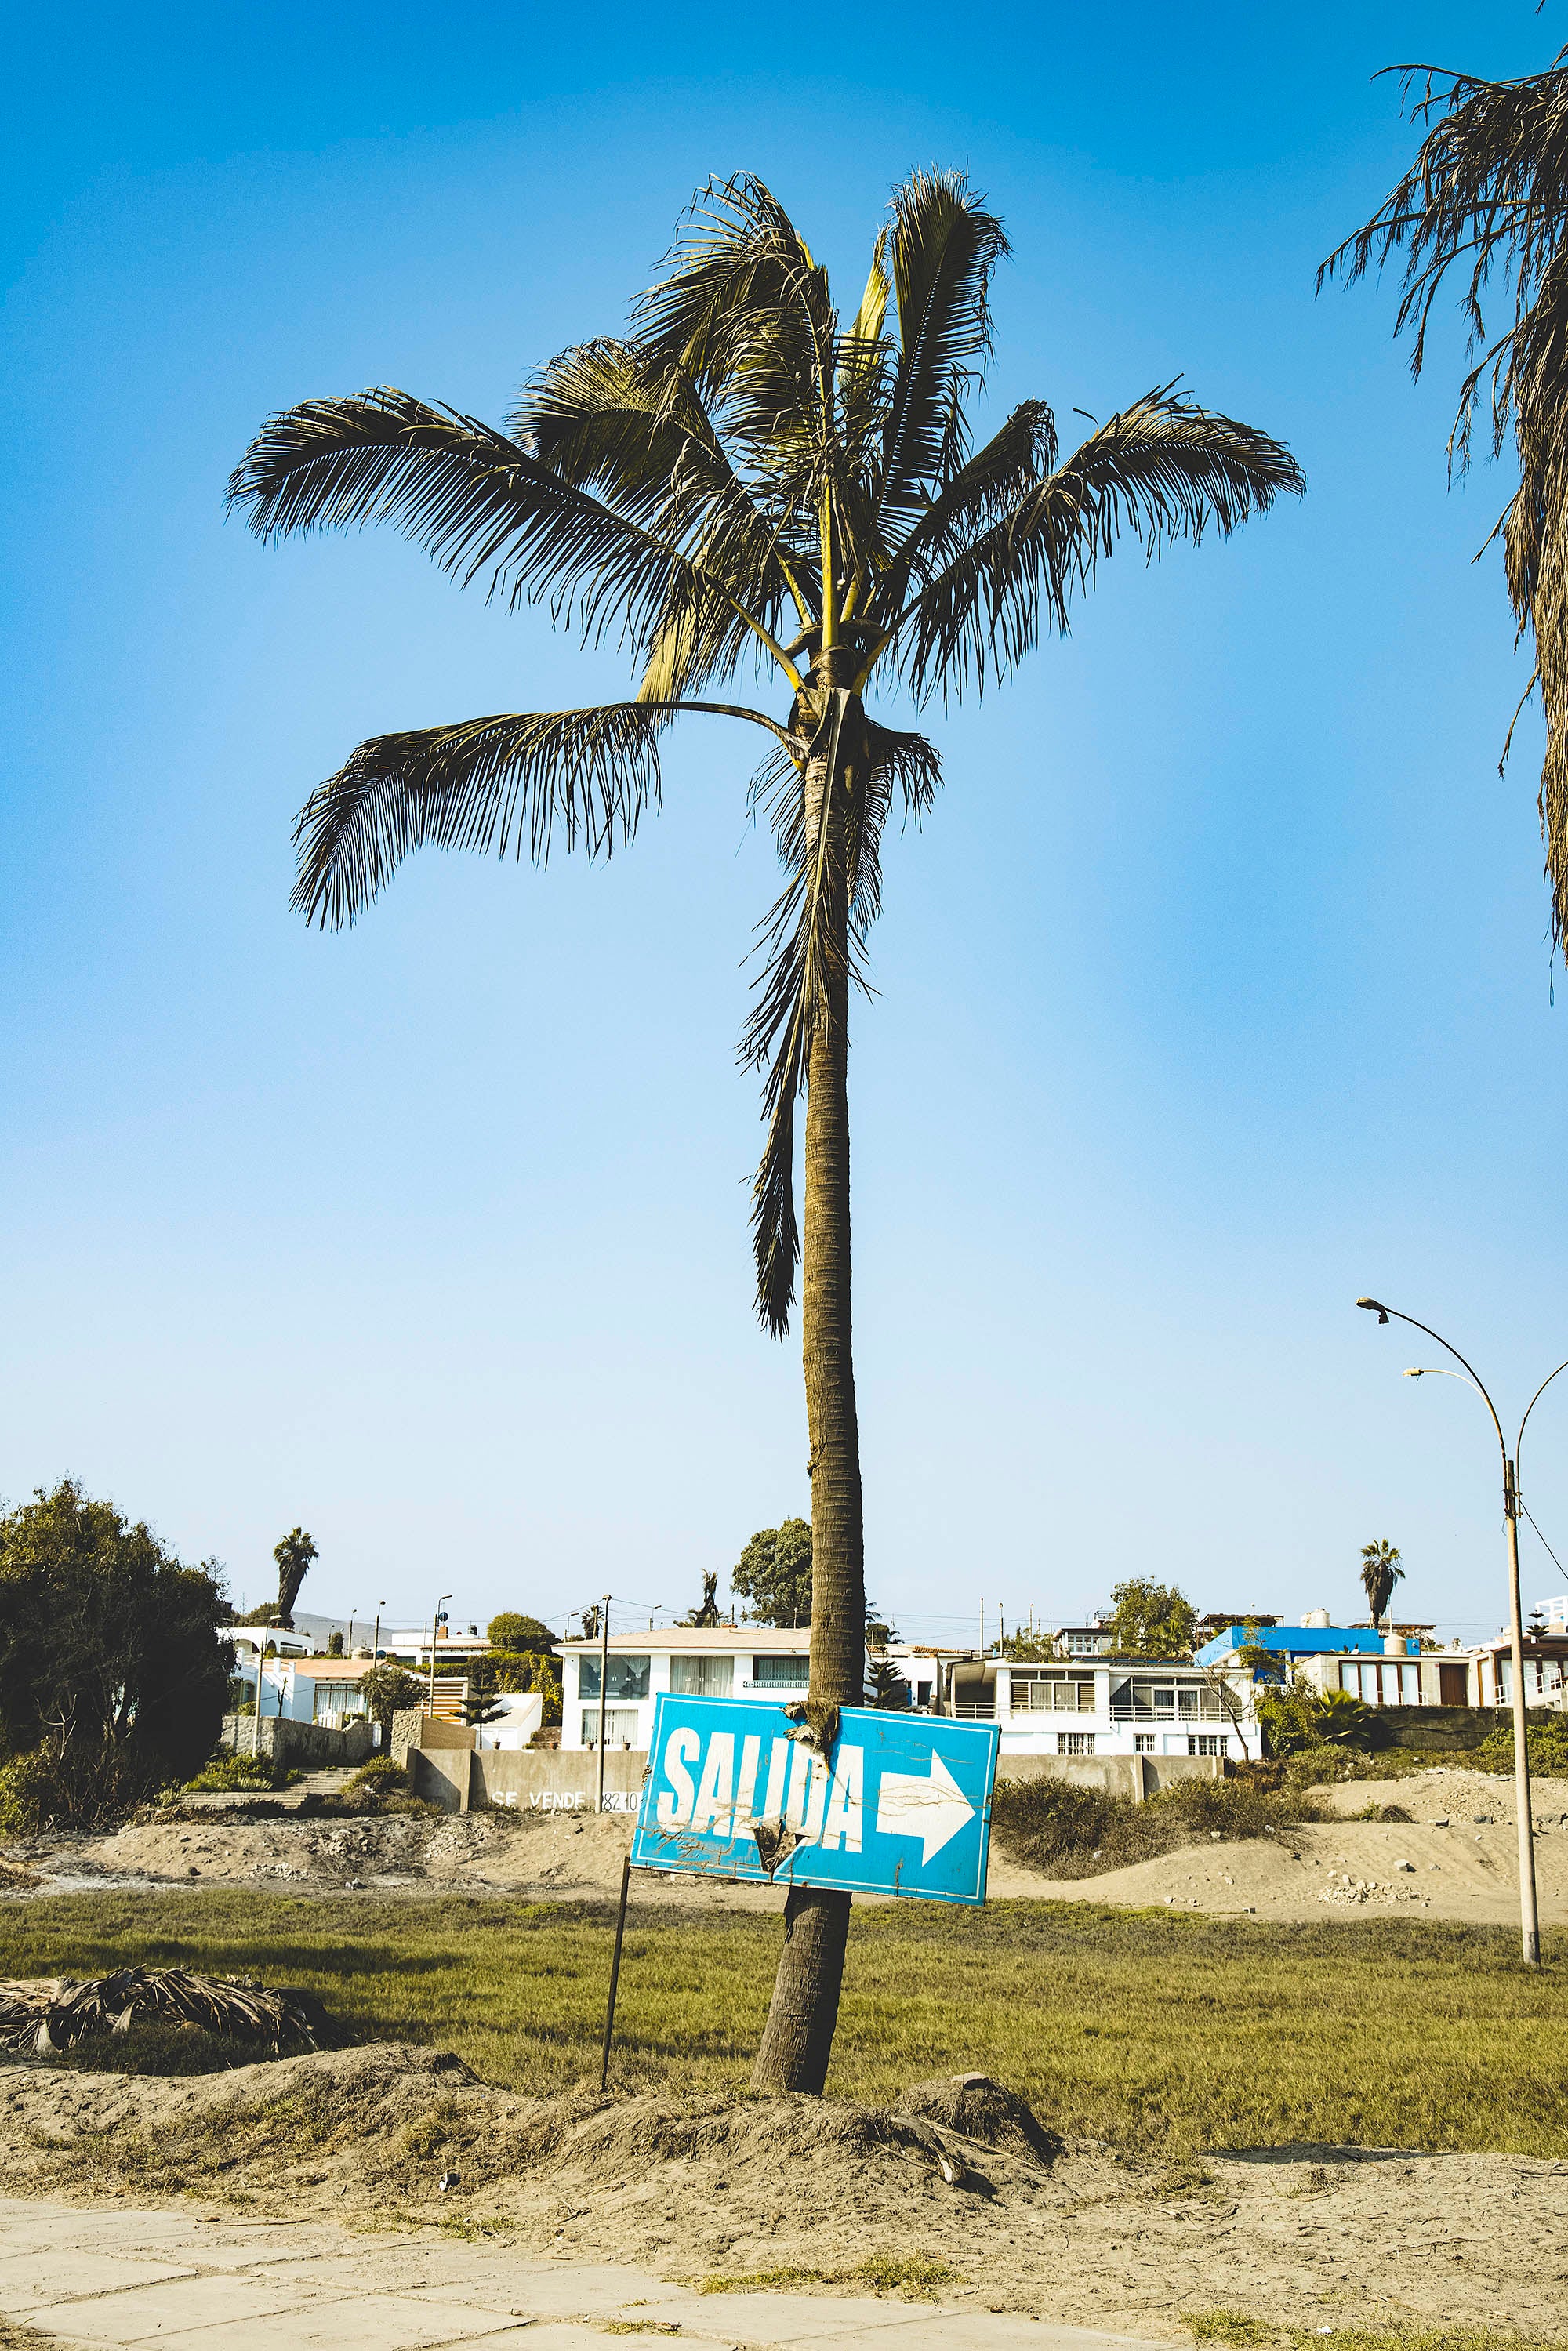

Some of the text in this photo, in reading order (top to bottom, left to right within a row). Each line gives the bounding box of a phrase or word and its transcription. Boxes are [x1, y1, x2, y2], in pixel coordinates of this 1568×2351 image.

[492, 1791, 518, 1809] SE
[529, 1791, 586, 1809] VENDE
[657, 1727, 863, 1853] SALIDA
